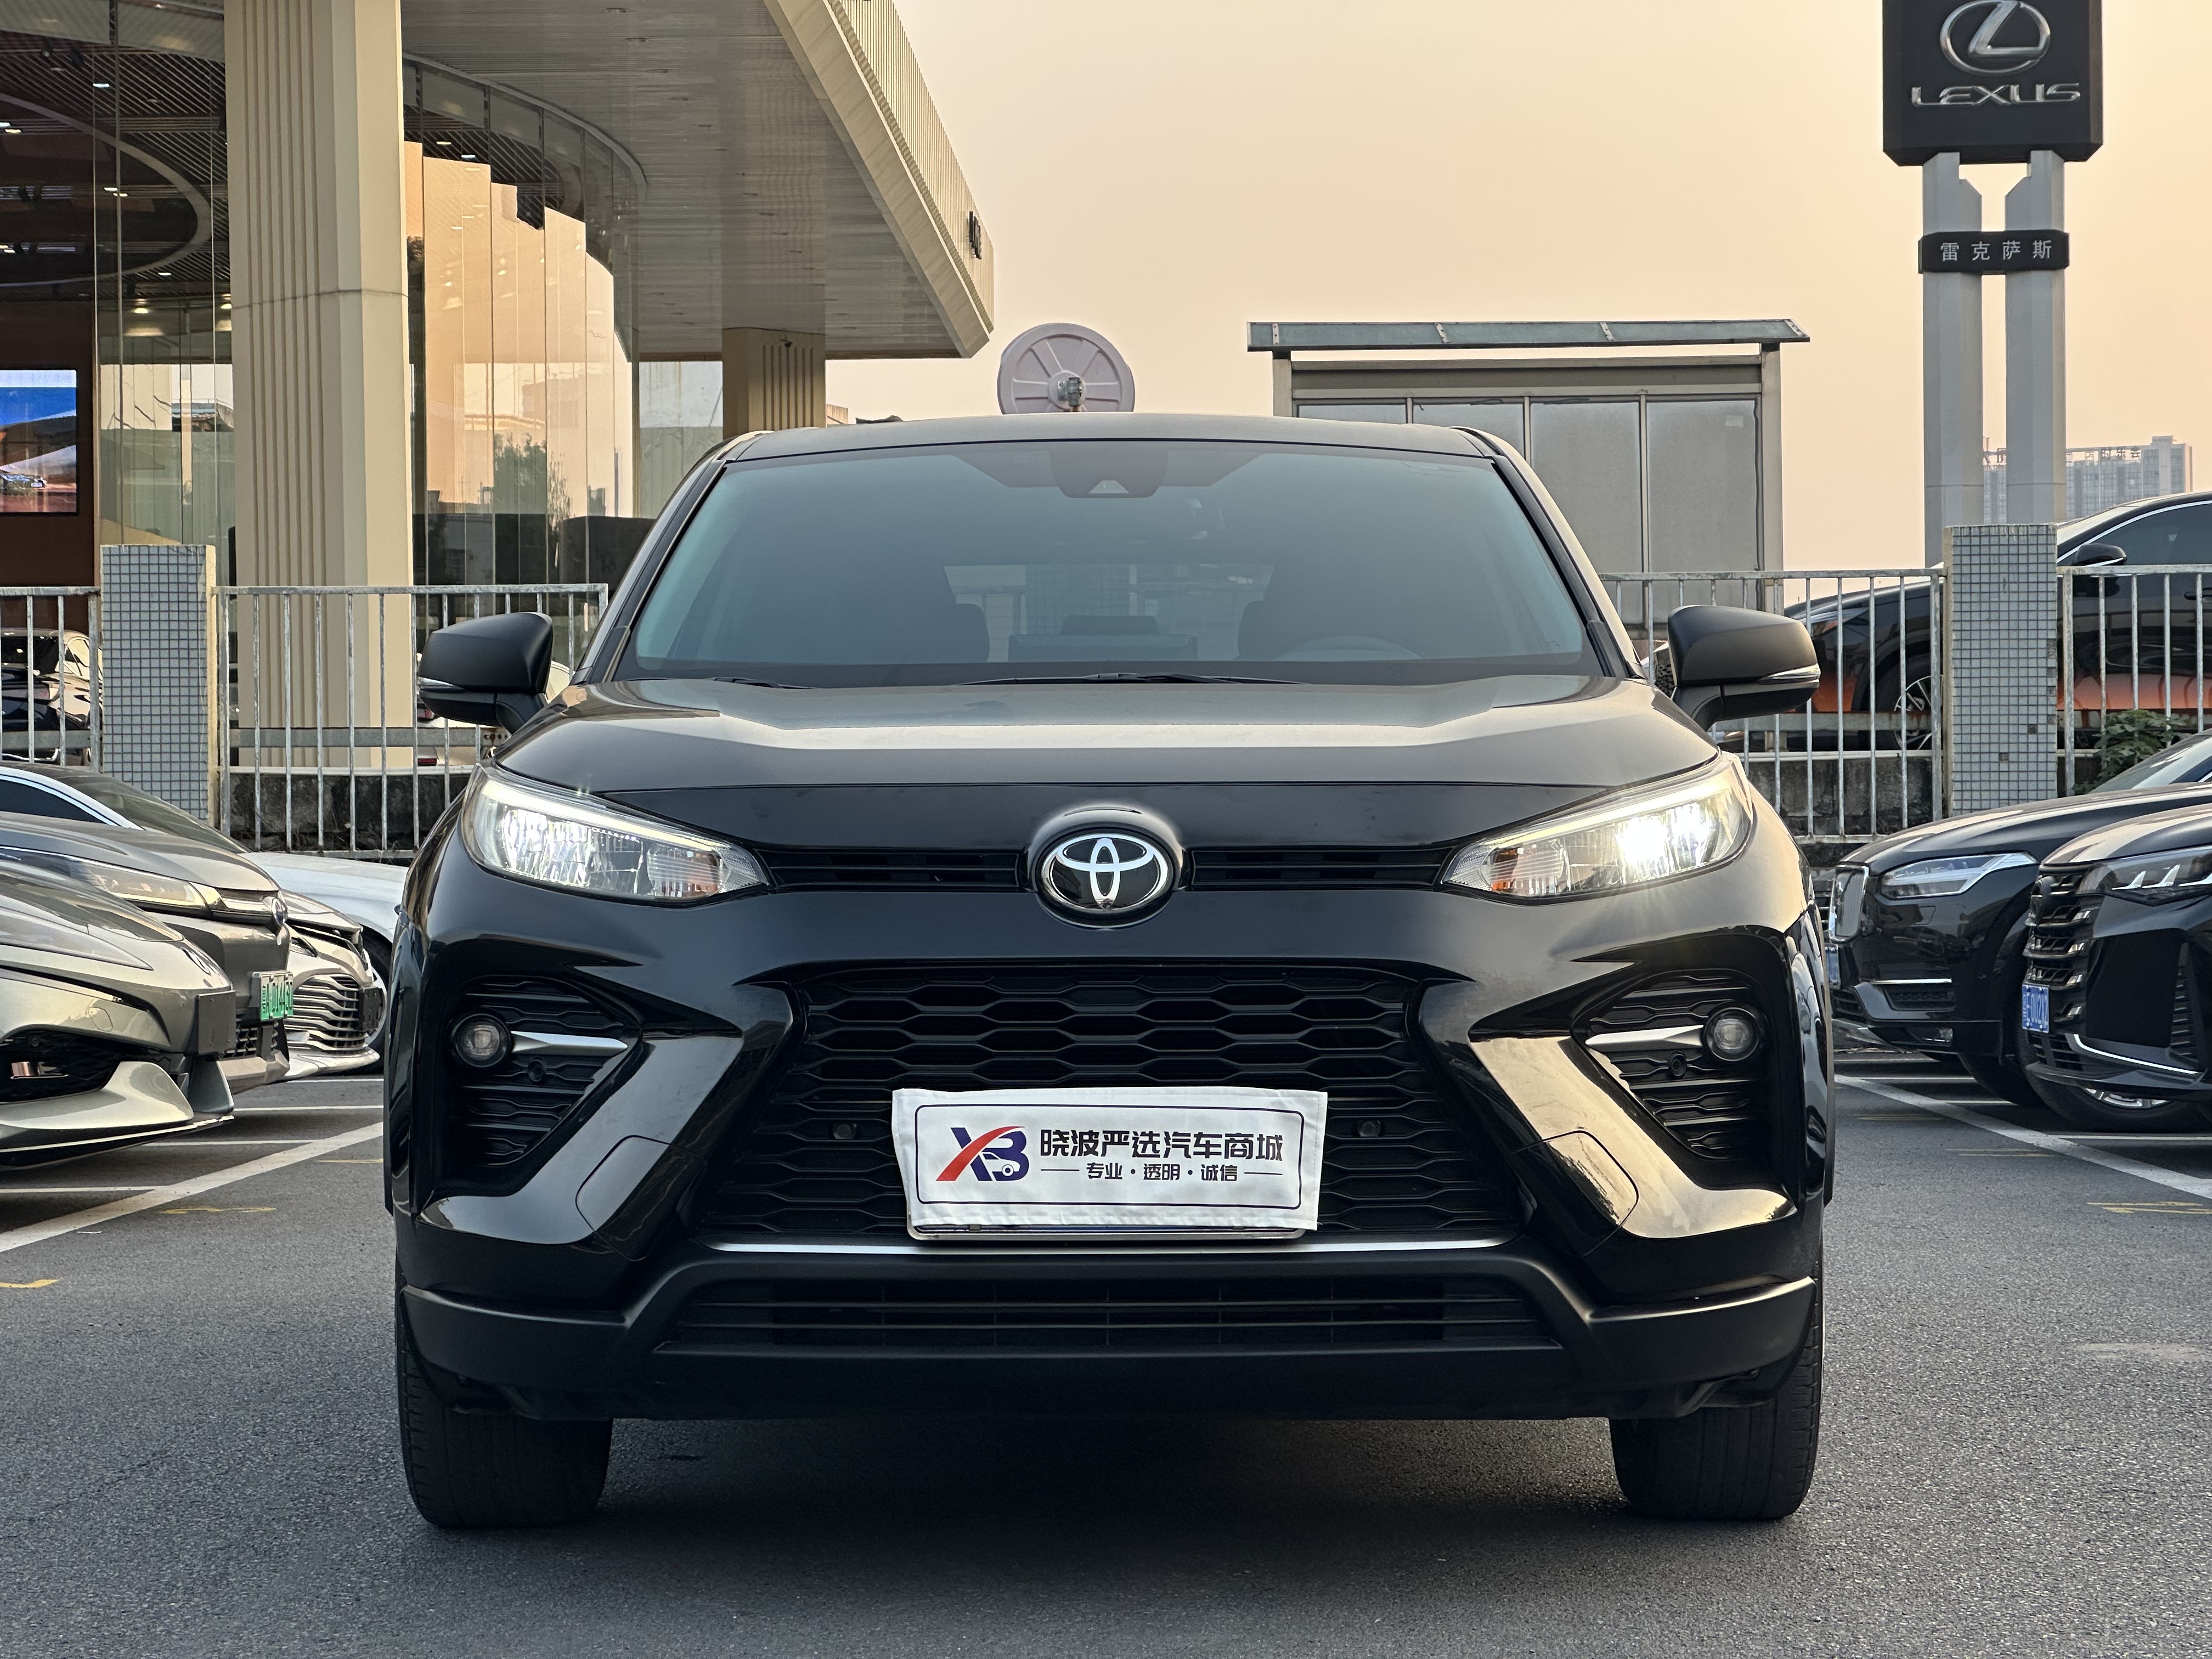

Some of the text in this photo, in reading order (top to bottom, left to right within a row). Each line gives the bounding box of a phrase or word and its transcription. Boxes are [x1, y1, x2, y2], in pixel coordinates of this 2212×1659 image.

[1911, 83, 2081, 106] LEXUS
[1940, 240, 2052, 262] 雷克萨斯
[1040, 1129, 1284, 1162] 晓波严选汽车商城
